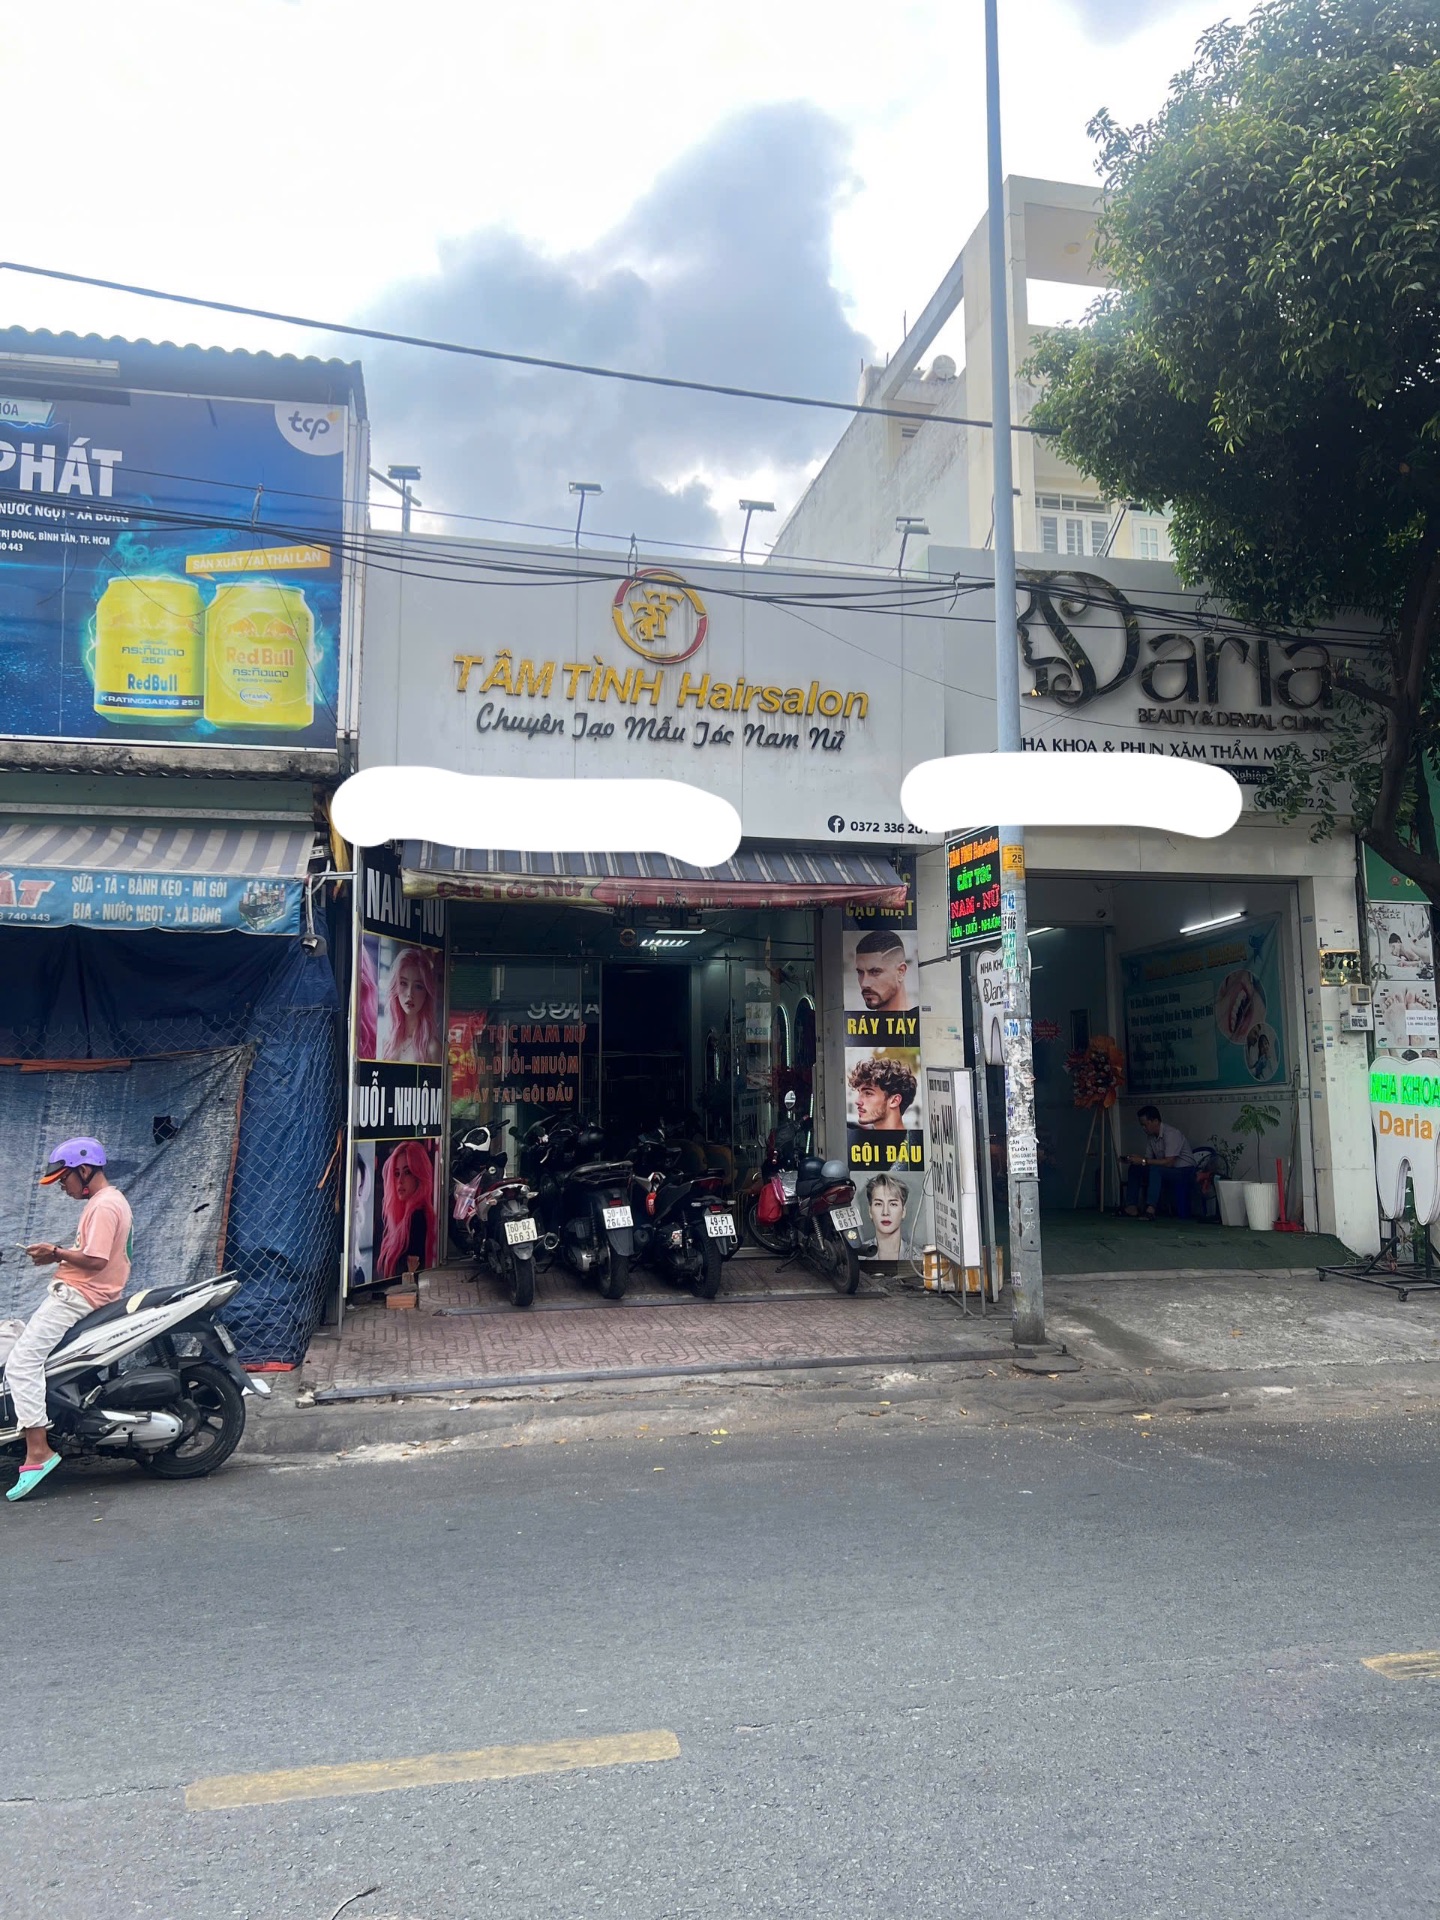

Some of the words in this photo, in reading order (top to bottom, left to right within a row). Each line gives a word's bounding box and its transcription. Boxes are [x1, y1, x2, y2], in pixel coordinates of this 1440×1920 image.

[0, 401, 18, 416] ÓA
[288, 411, 330, 440] tcp
[8, 543, 23, 551] 443
[11, 529, 37, 541] ĐÔNG,
[38, 529, 59, 541] BÌNH
[92, 536, 110, 546] HCM
[295, 551, 321, 563] LAN
[453, 649, 557, 698] TÂM
[562, 655, 664, 706] TÌNH
[677, 672, 869, 719] Hairsalon
[476, 702, 565, 740] Chuyên
[624, 715, 685, 741] Mẫu
[693, 721, 735, 748] Tóc
[743, 723, 799, 750] Nam
[809, 727, 845, 752] Nữ
[1138, 707, 1198, 725] BEAUTY
[1201, 710, 1214, 725] &
[1217, 712, 1277, 731] DENTAL
[1021, 738, 1047, 751] HA
[1053, 738, 1098, 753] KHOA
[1103, 740, 1115, 753] &
[1170, 742, 1206, 758] XĂM
[1211, 739, 1258, 760] THẨM
[1313, 748, 1337, 763] SP
[850, 821, 880, 833] 0372
[884, 822, 904, 833] 336
[907, 823, 928, 834] 20
[1012, 854, 1022, 864] 25
[128, 875, 158, 896] BÁNH
[161, 879, 181, 899] KẸO
[209, 880, 228, 898] GÓI
[366, 867, 411, 929] NAM
[73, 902, 91, 920] BIA
[102, 901, 133, 921] NƯỚC
[136, 904, 165, 925] NGỌT
[174, 902, 188, 922] XÀ
[191, 904, 222, 923] BÔNG
[951, 896, 975, 919] NAM
[982, 884, 1000, 910] NỮ
[8, 913, 28, 921] 740
[31, 914, 50, 922] 443
[980, 961, 992, 974] NHA
[983, 979, 1004, 1003] Dari
[521, 1024, 560, 1043] NAM
[847, 1015, 880, 1034] RÁY
[886, 1018, 917, 1034] TAY
[547, 1081, 574, 1102] ĐẦU
[1370, 1072, 1397, 1103] NHA
[1401, 1074, 1440, 1107] KHOA
[393, 1080, 442, 1134] NHUỘM
[1379, 1109, 1433, 1139] Daria
[851, 1142, 880, 1166] GỘI
[886, 1139, 922, 1162] ĐẦU
[710, 1216, 729, 1226] 49-F1
